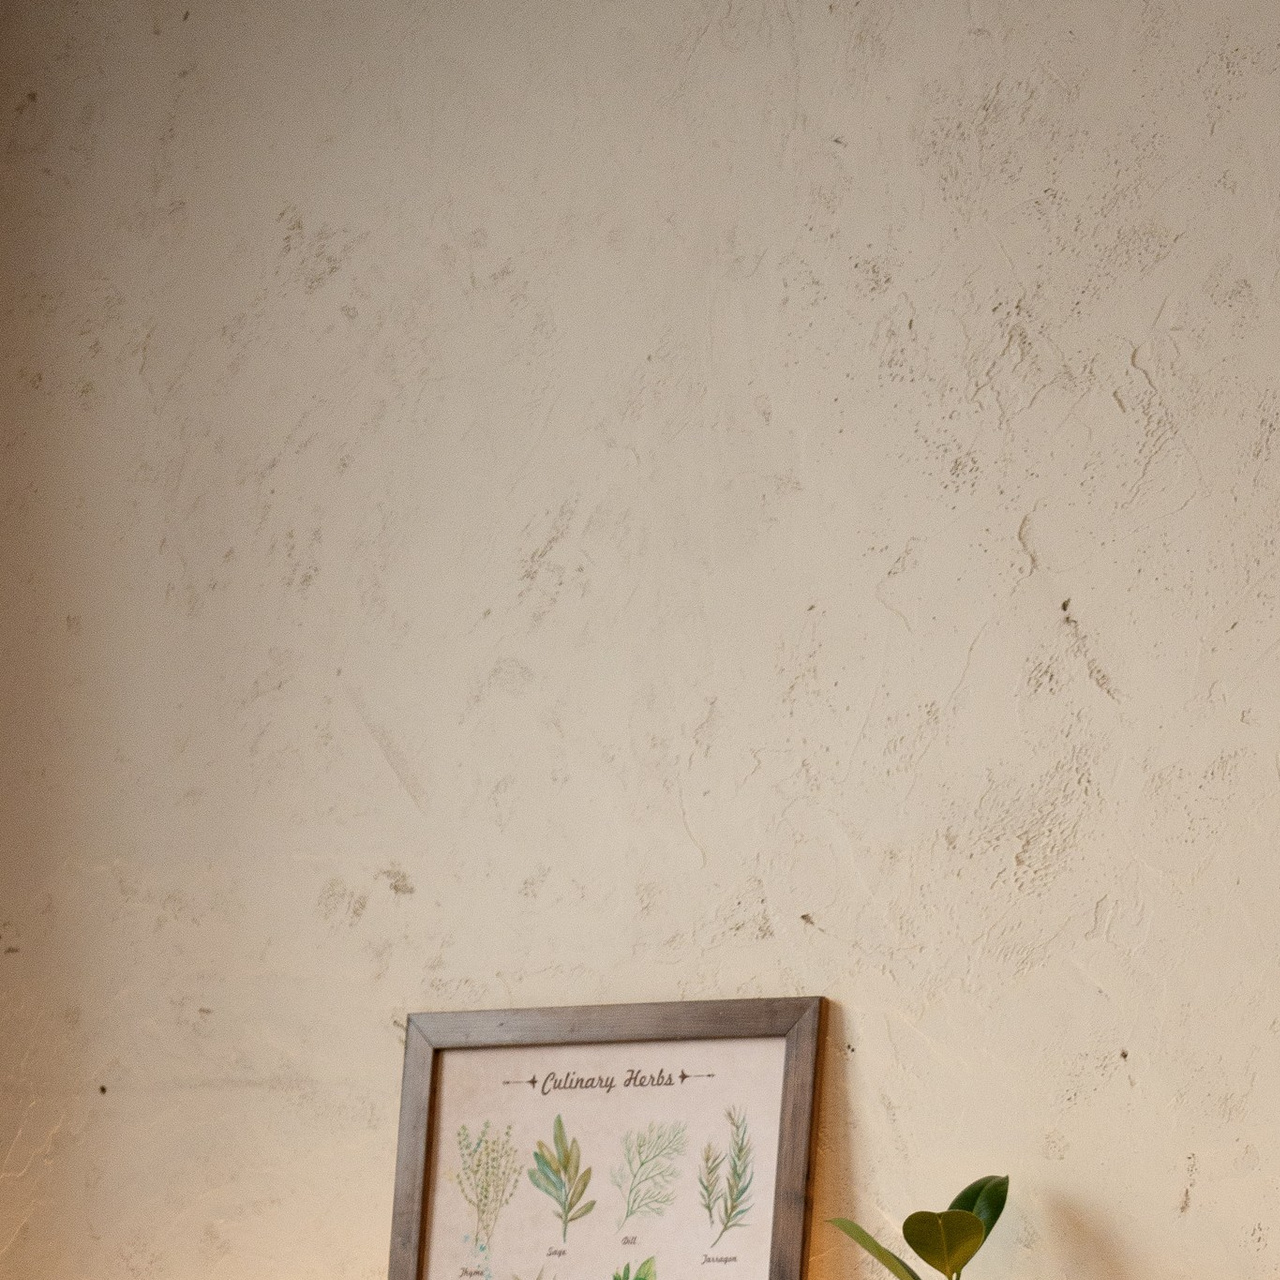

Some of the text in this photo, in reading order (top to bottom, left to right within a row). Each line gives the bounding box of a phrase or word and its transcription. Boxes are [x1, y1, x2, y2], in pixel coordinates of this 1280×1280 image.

[541, 1068, 675, 1096] Culinary Herbs
[621, 1235, 637, 1245] Dill
[546, 1246, 567, 1258] Sage
